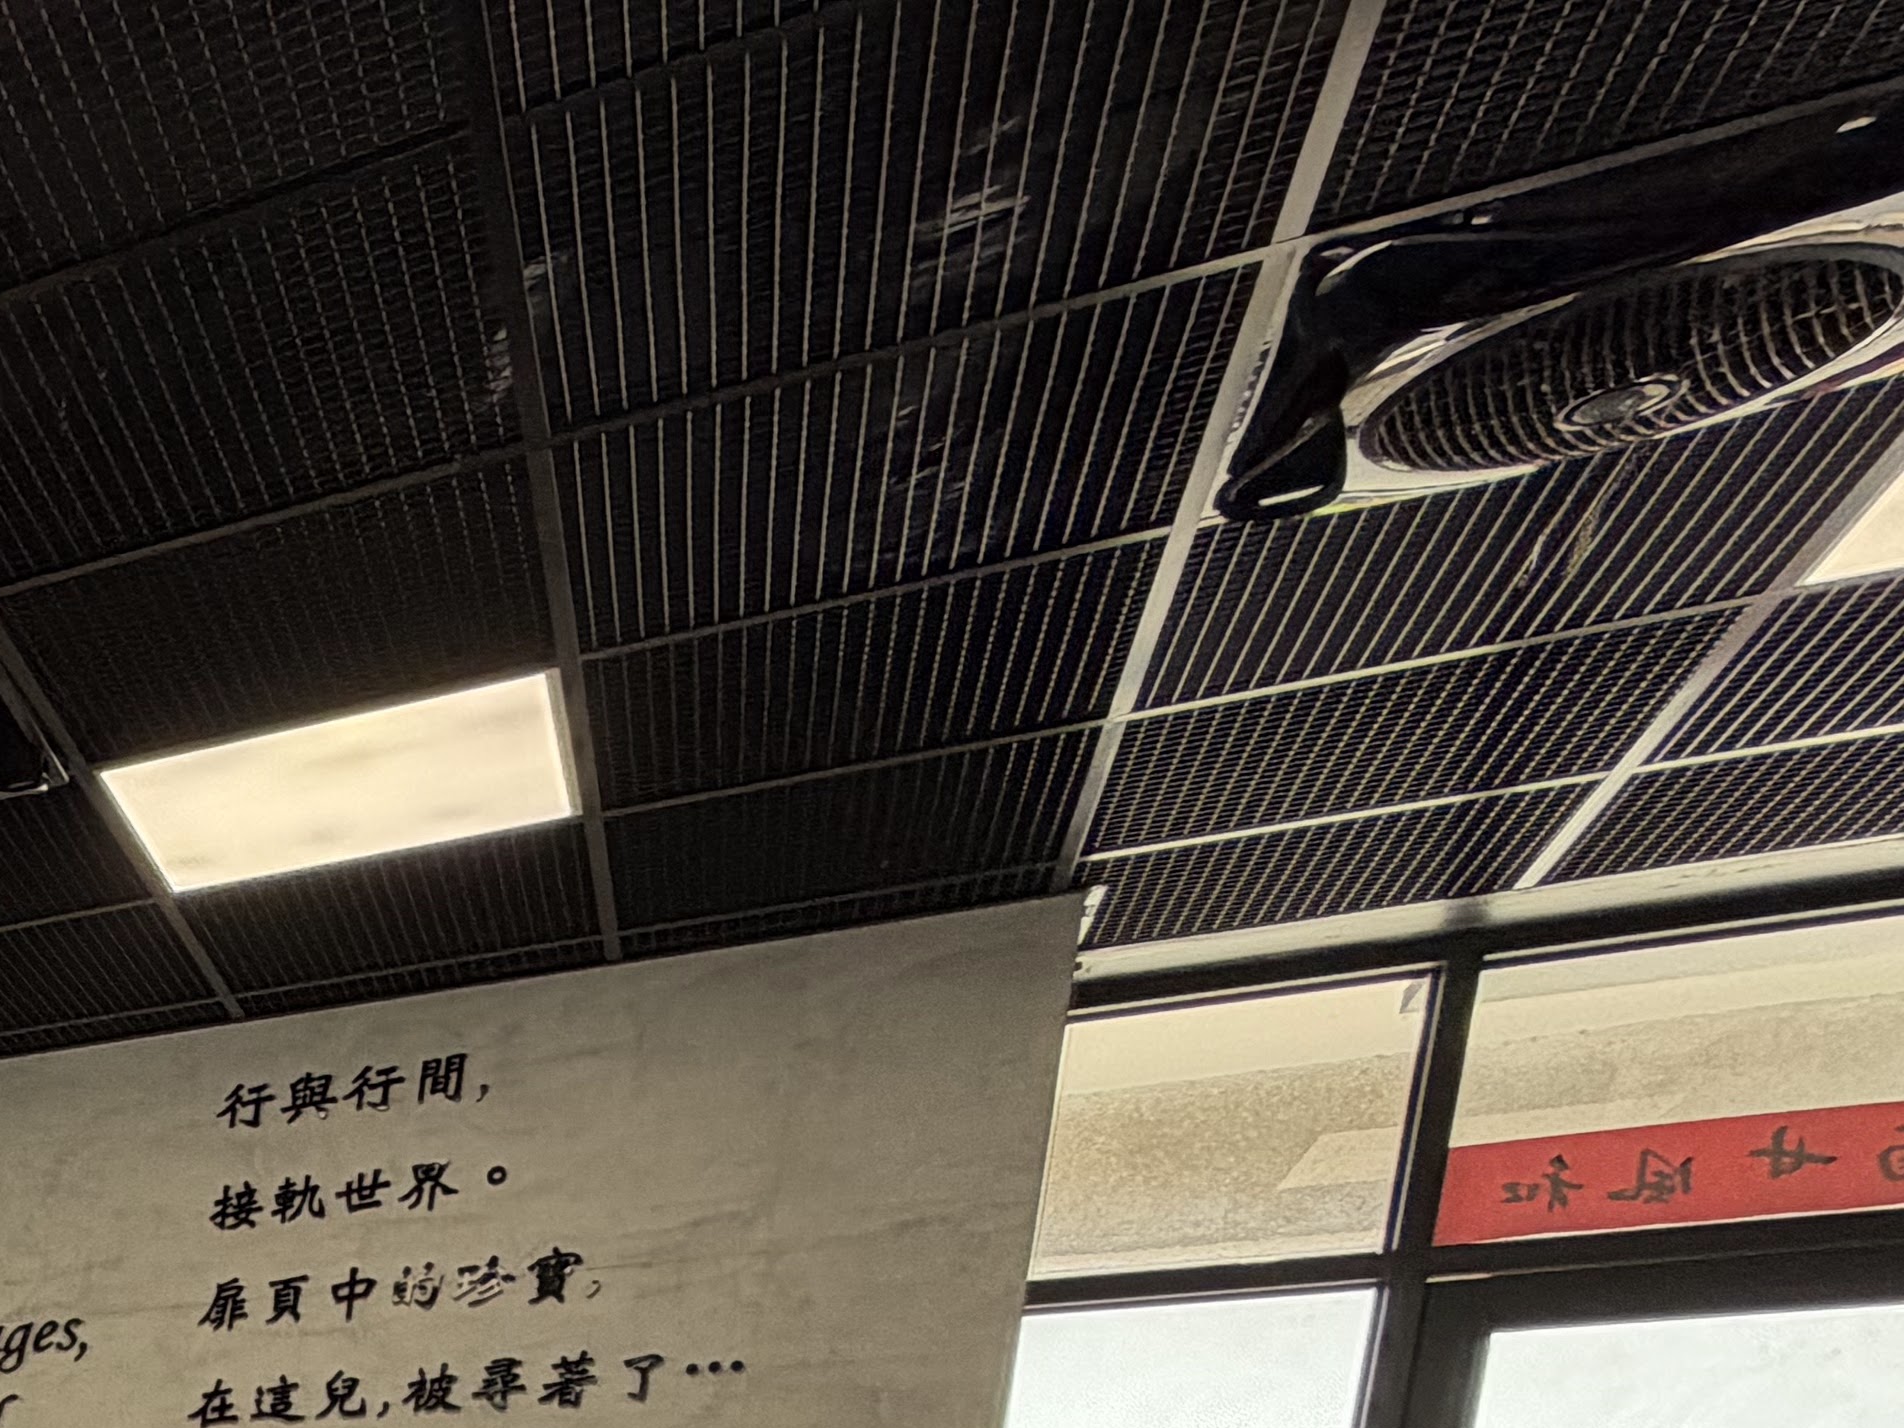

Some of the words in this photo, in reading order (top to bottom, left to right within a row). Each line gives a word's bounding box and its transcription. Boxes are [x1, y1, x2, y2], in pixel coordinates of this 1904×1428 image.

[216, 1052, 491, 1129] 行與行間，
[209, 1161, 508, 1231] 接軌世界。
